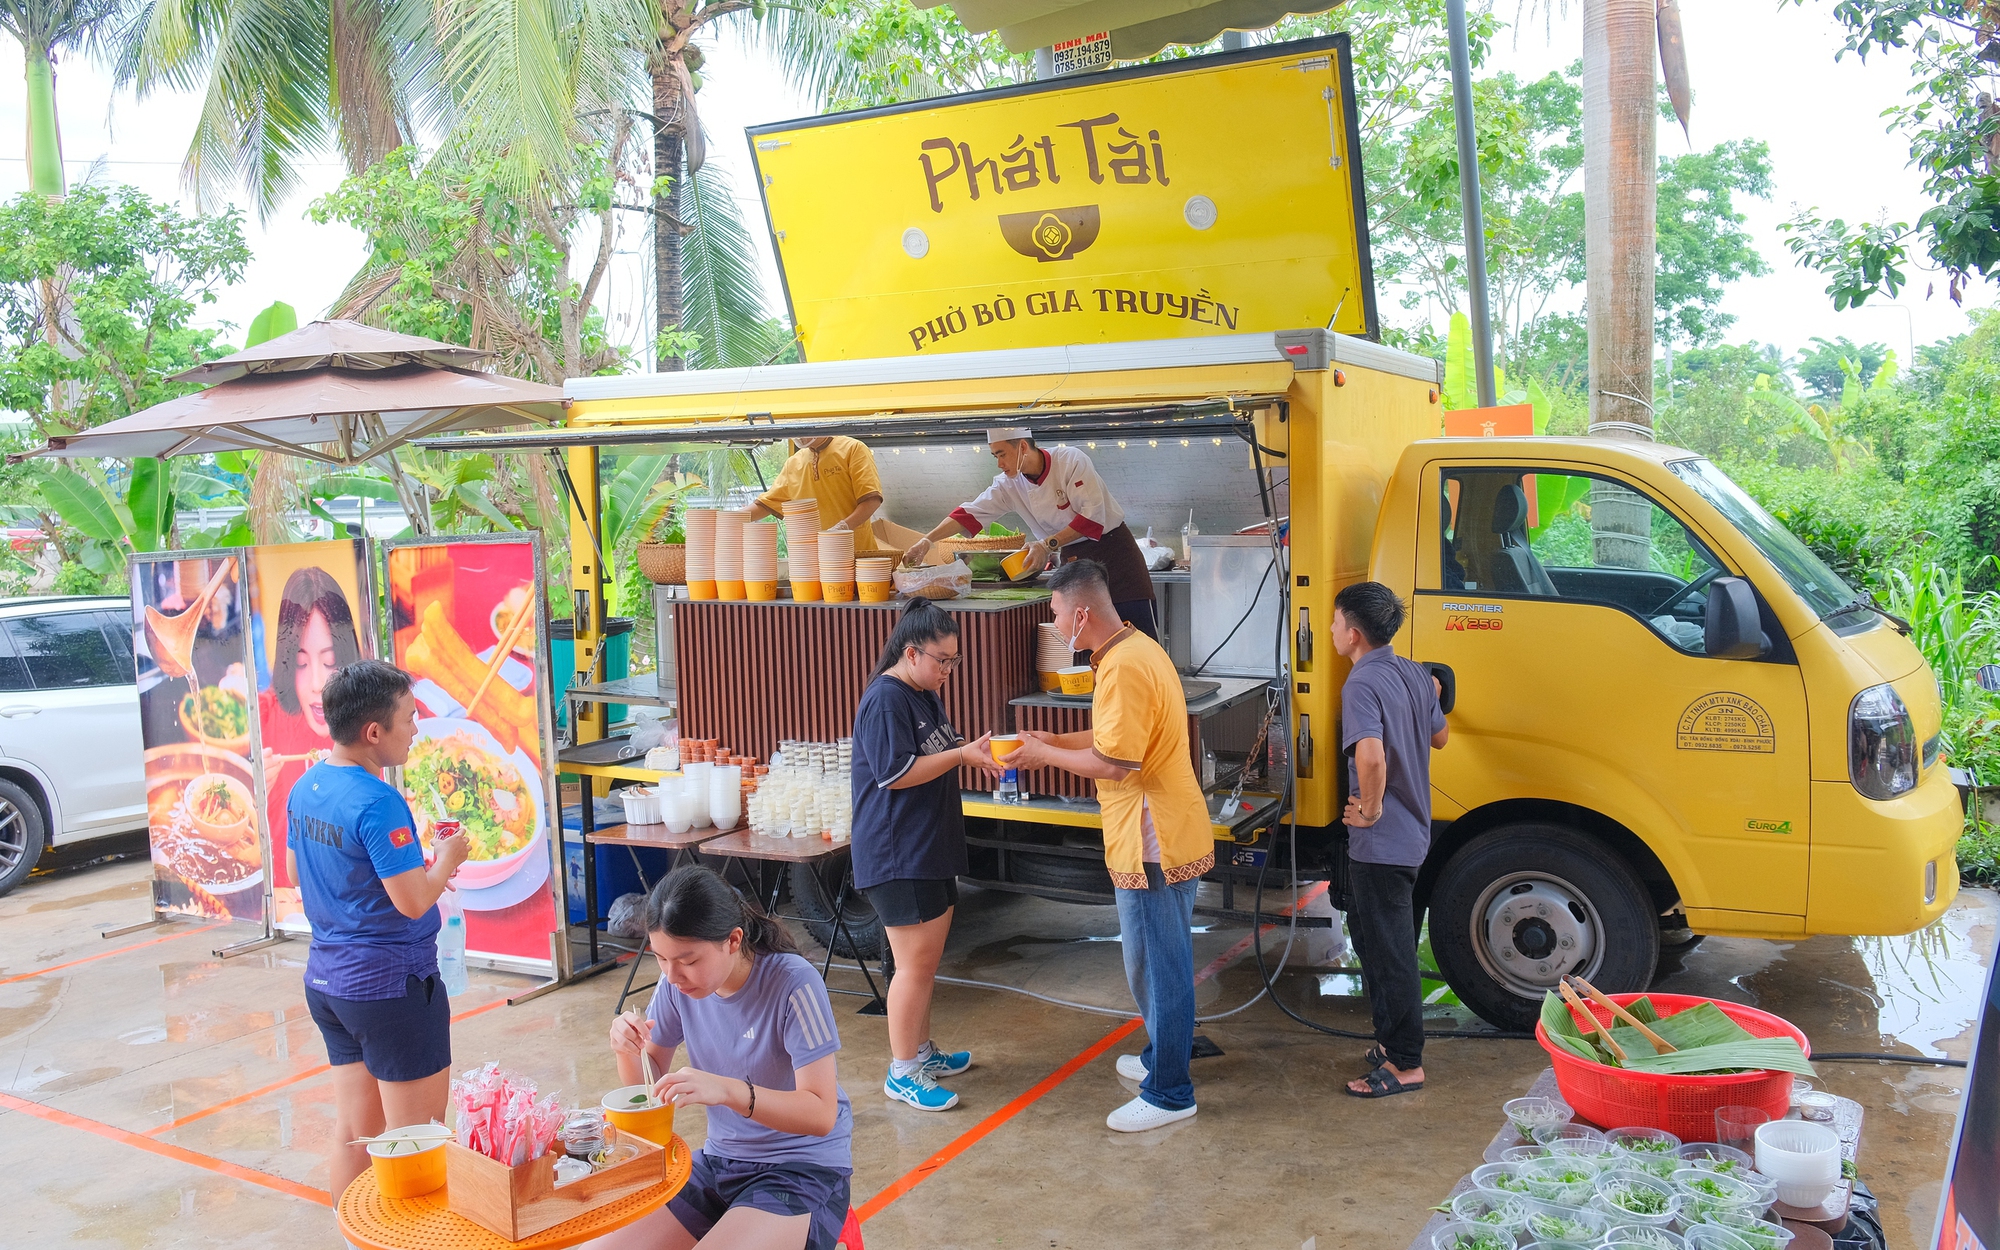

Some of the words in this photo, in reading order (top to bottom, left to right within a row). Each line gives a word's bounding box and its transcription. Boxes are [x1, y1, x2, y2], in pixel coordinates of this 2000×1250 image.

[1054, 39, 1110, 63] 0937.194.879
[1055, 50, 1111, 74] 0785.914.879
[918, 133, 1060, 214] Phát
[1055, 112, 1170, 187] Tài
[908, 304, 968, 351] PHỞ
[972, 293, 1016, 327] BÒ
[1025, 289, 1083, 316] GIA
[1091, 287, 1240, 331] TRUYỀN
[1442, 602, 1503, 613] FRONTIER
[1445, 615, 1504, 631] K250
[1690, 700, 1709, 716] TNHH
[1709, 696, 1725, 705] MTV
[1726, 696, 1743, 706] XNK
